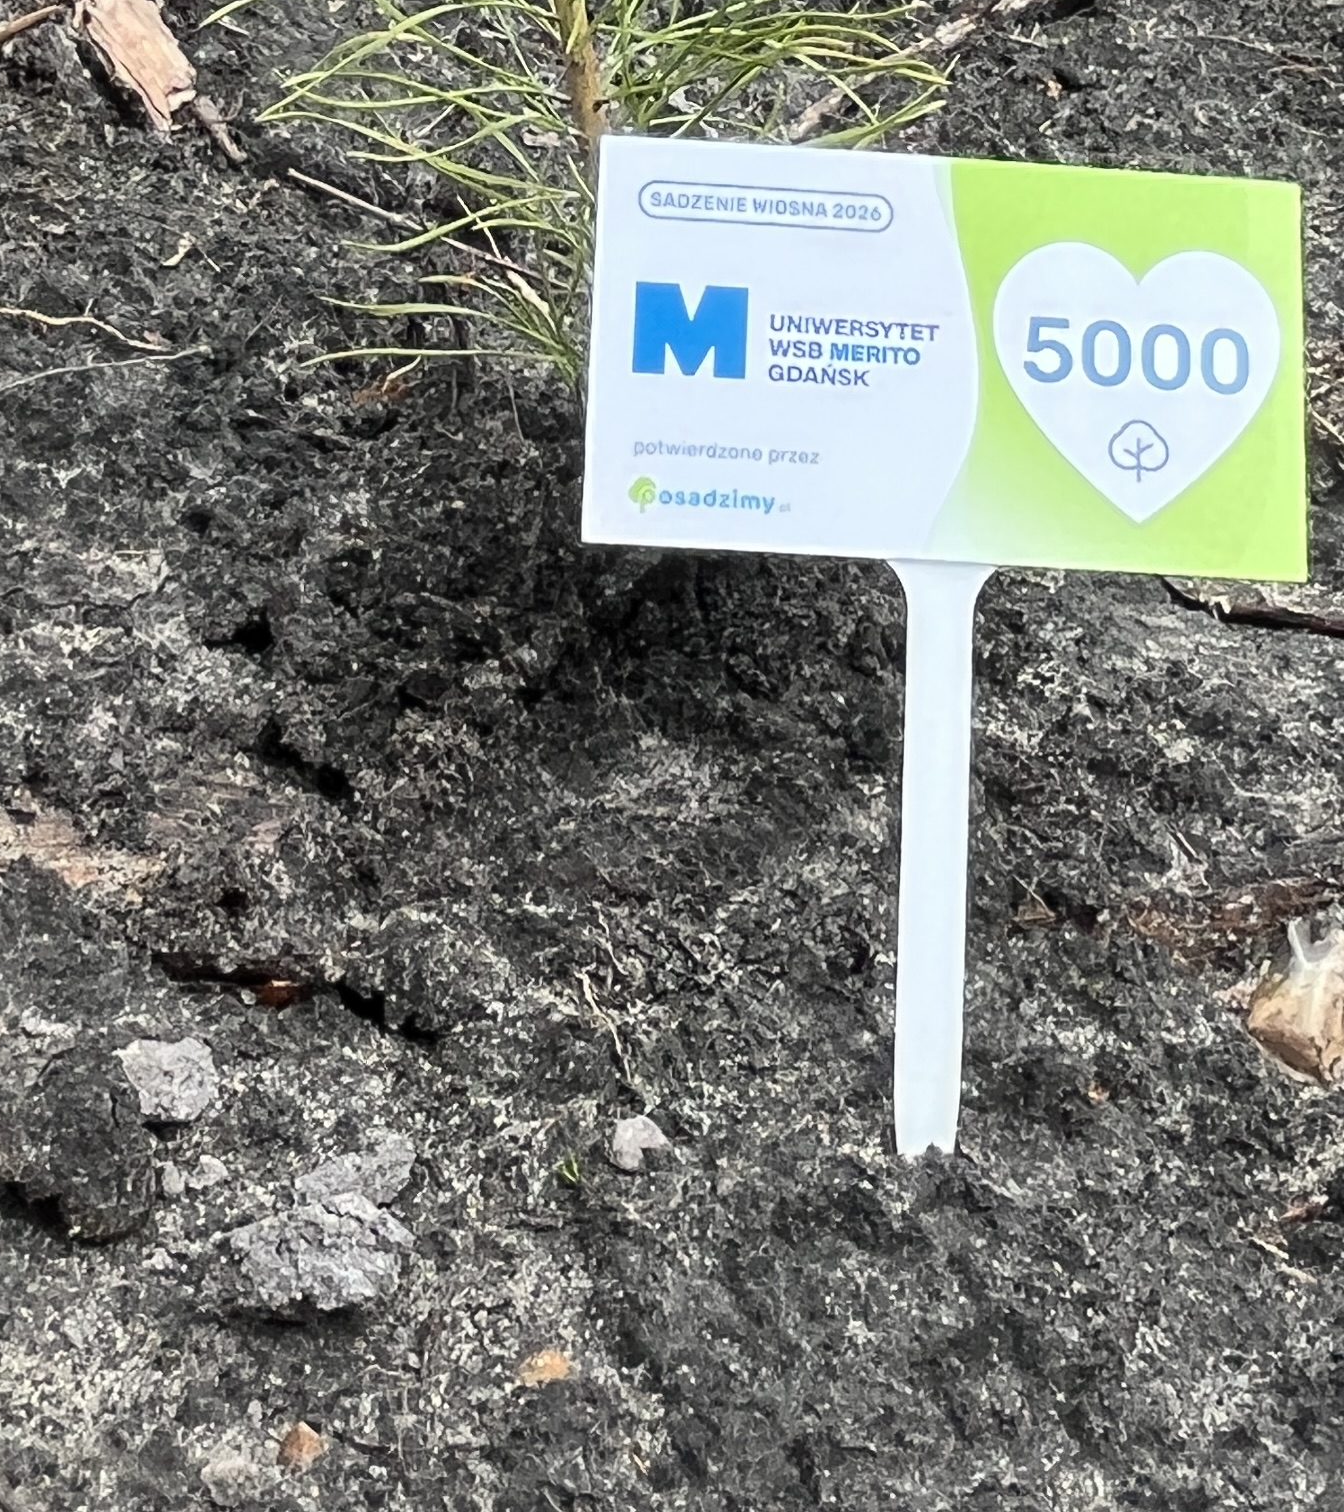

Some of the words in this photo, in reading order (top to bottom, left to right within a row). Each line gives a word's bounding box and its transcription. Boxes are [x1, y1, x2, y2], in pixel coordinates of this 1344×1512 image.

[650, 191, 748, 213] SADZENIE
[753, 197, 828, 218] WIOSNA
[832, 203, 882, 222] 2026
[632, 281, 749, 379] M
[770, 314, 940, 341] UNIWERSYTET
[769, 338, 823, 359] WSB
[830, 343, 921, 365] MERITO
[1023, 316, 1249, 395] 5000
[768, 364, 870, 387] GDAŃSK
[633, 440, 763, 462] potwierdzone
[768, 448, 820, 465] przez
